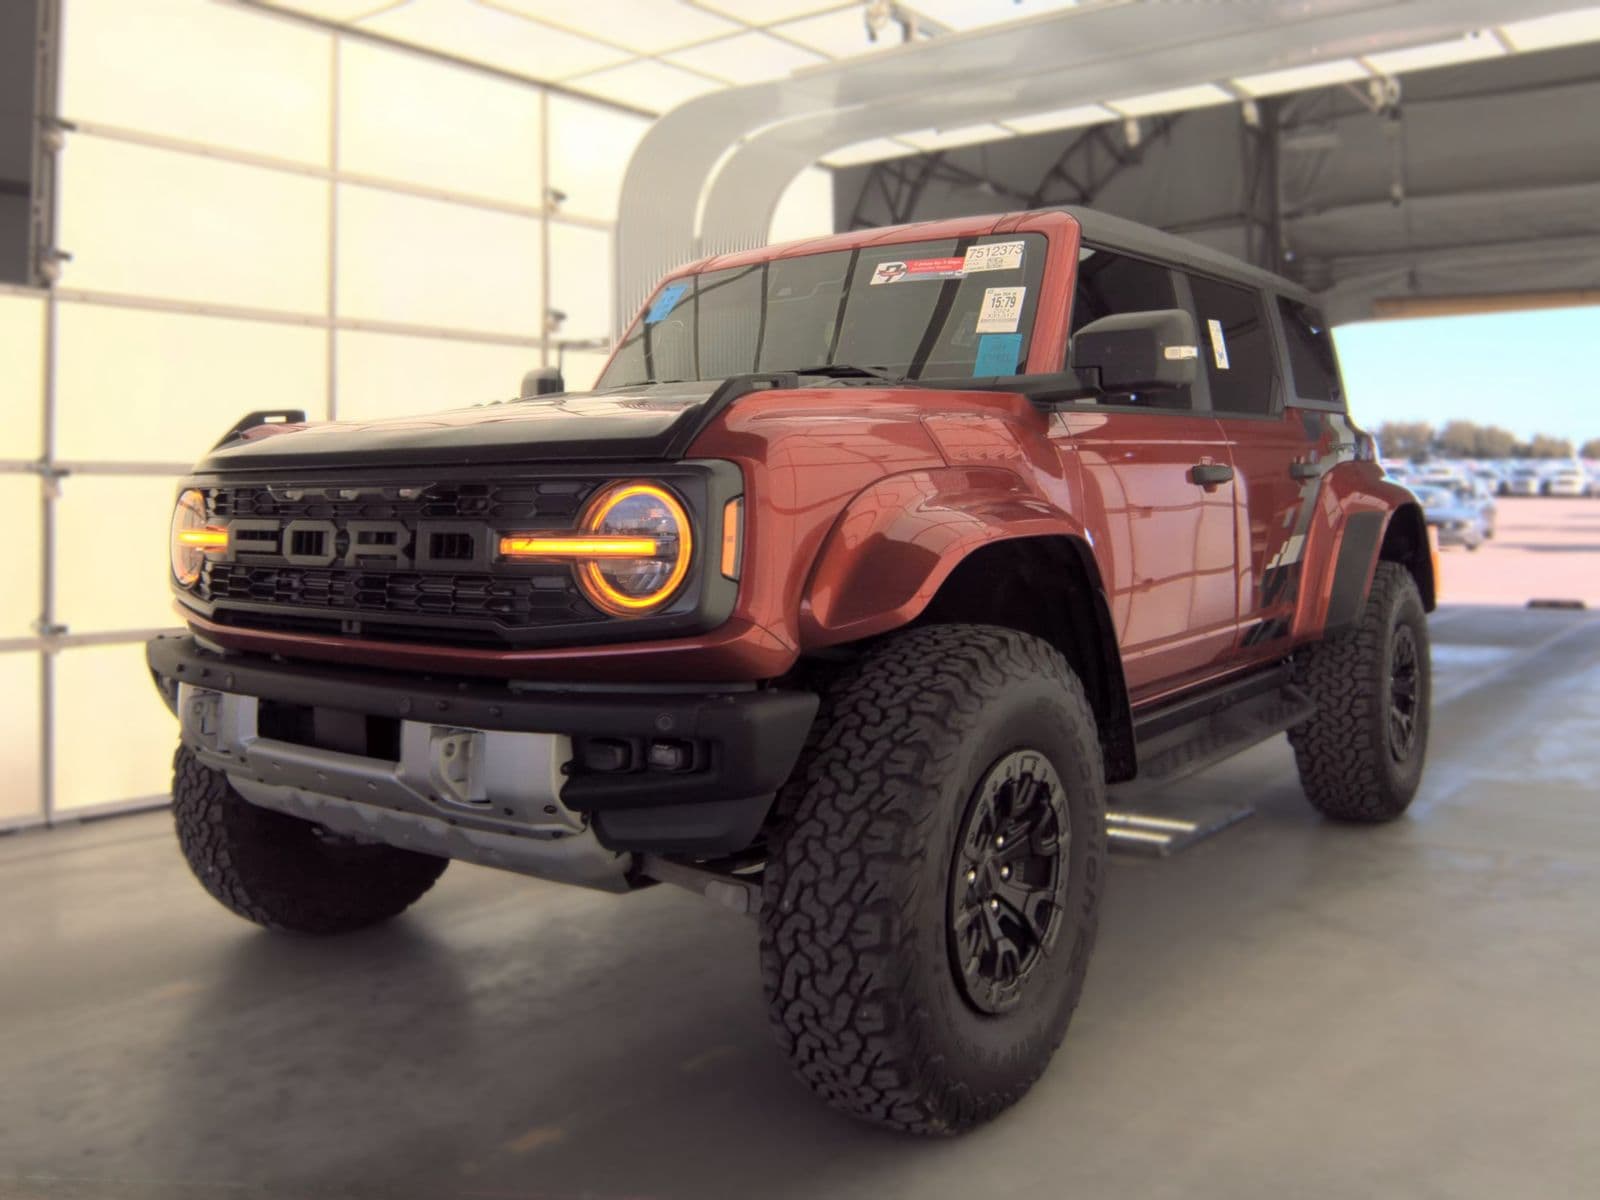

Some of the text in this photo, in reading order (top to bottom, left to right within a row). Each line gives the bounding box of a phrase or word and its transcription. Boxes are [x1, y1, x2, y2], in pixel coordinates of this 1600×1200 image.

[968, 244, 1024, 259] 7512373
[991, 296, 1017, 309] 15:79
[227, 518, 499, 571] FORD
